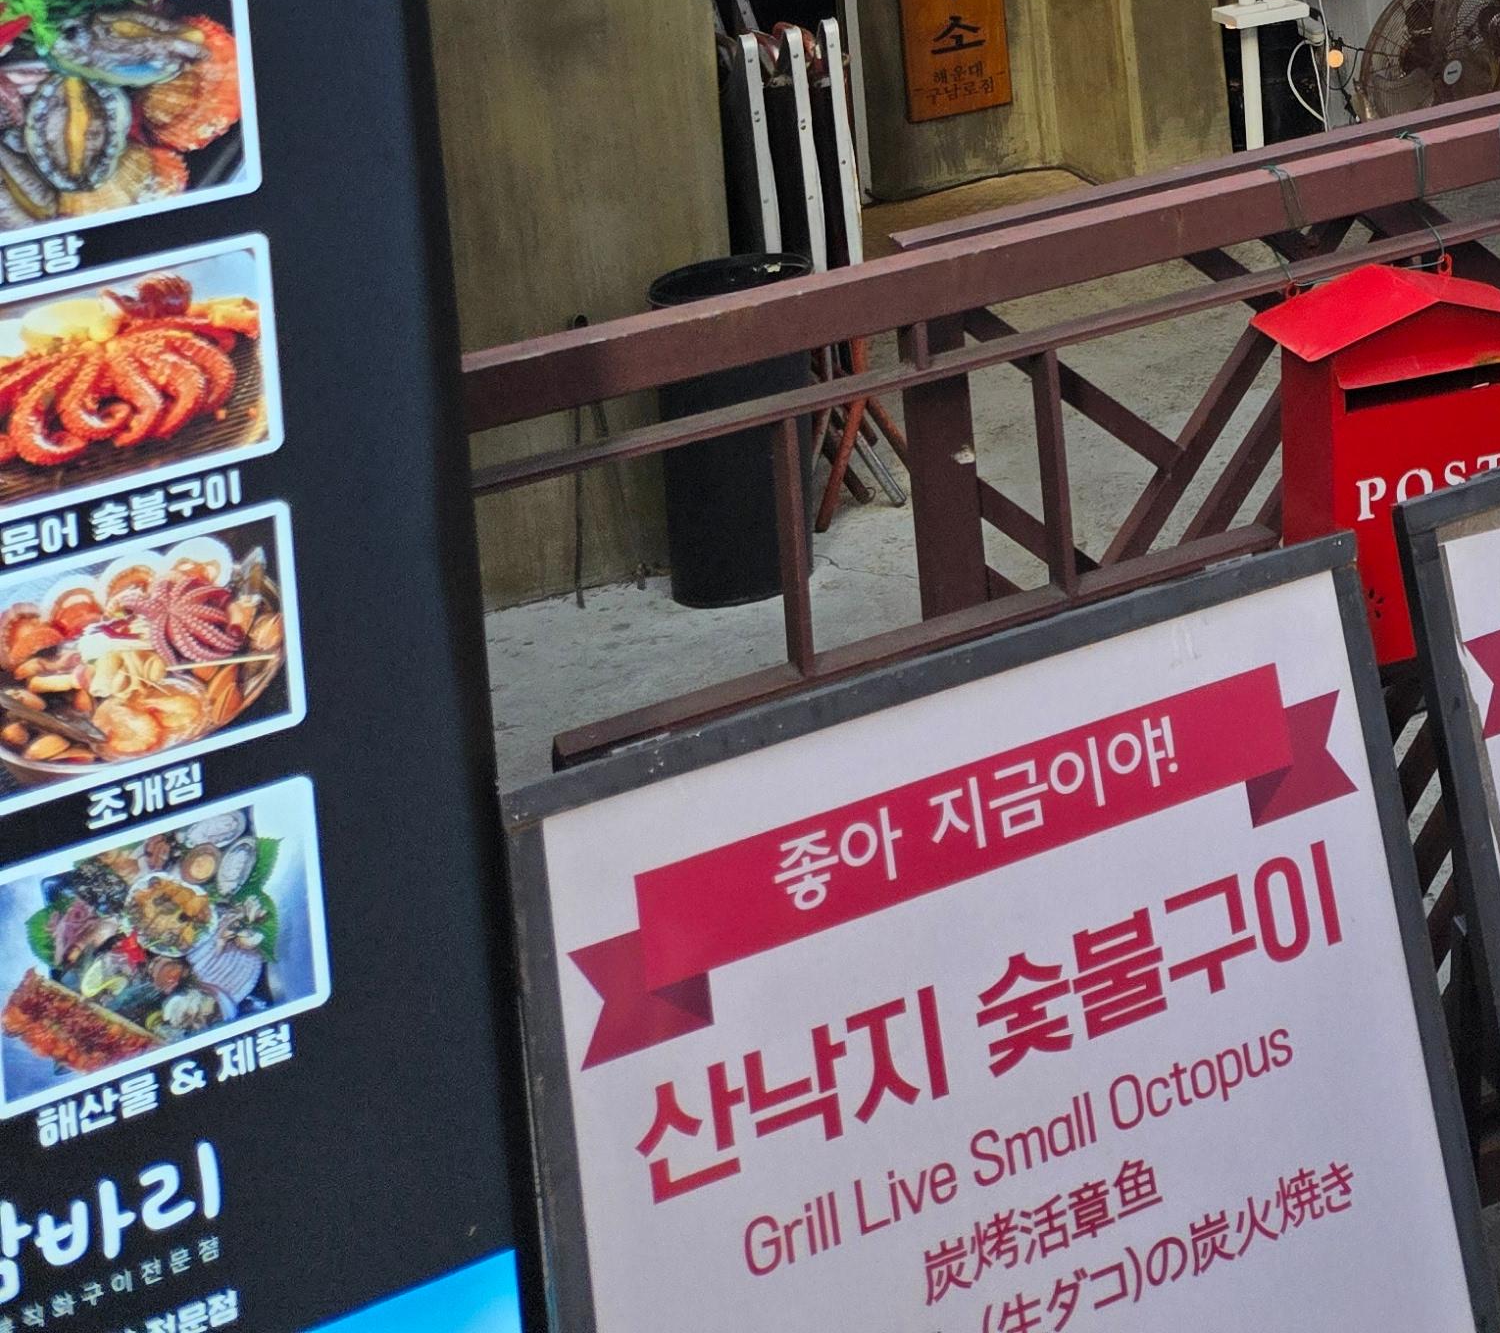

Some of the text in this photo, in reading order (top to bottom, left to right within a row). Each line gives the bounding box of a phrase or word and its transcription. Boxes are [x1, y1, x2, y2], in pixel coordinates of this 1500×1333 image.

[0, 236, 85, 285] 물탕
[1, 468, 242, 565] 문어 숯불구이
[87, 761, 203, 831] 조개찜
[774, 715, 1181, 911] 좋아 지금이야!
[37, 1023, 293, 1148] 해산물 & 제철
[634, 840, 1345, 1204] 산낙지 숯불구이
[743, 1026, 1295, 1278] Grill Live Small Octopus
[923, 1158, 1164, 1307] 炭烤活章鱼
